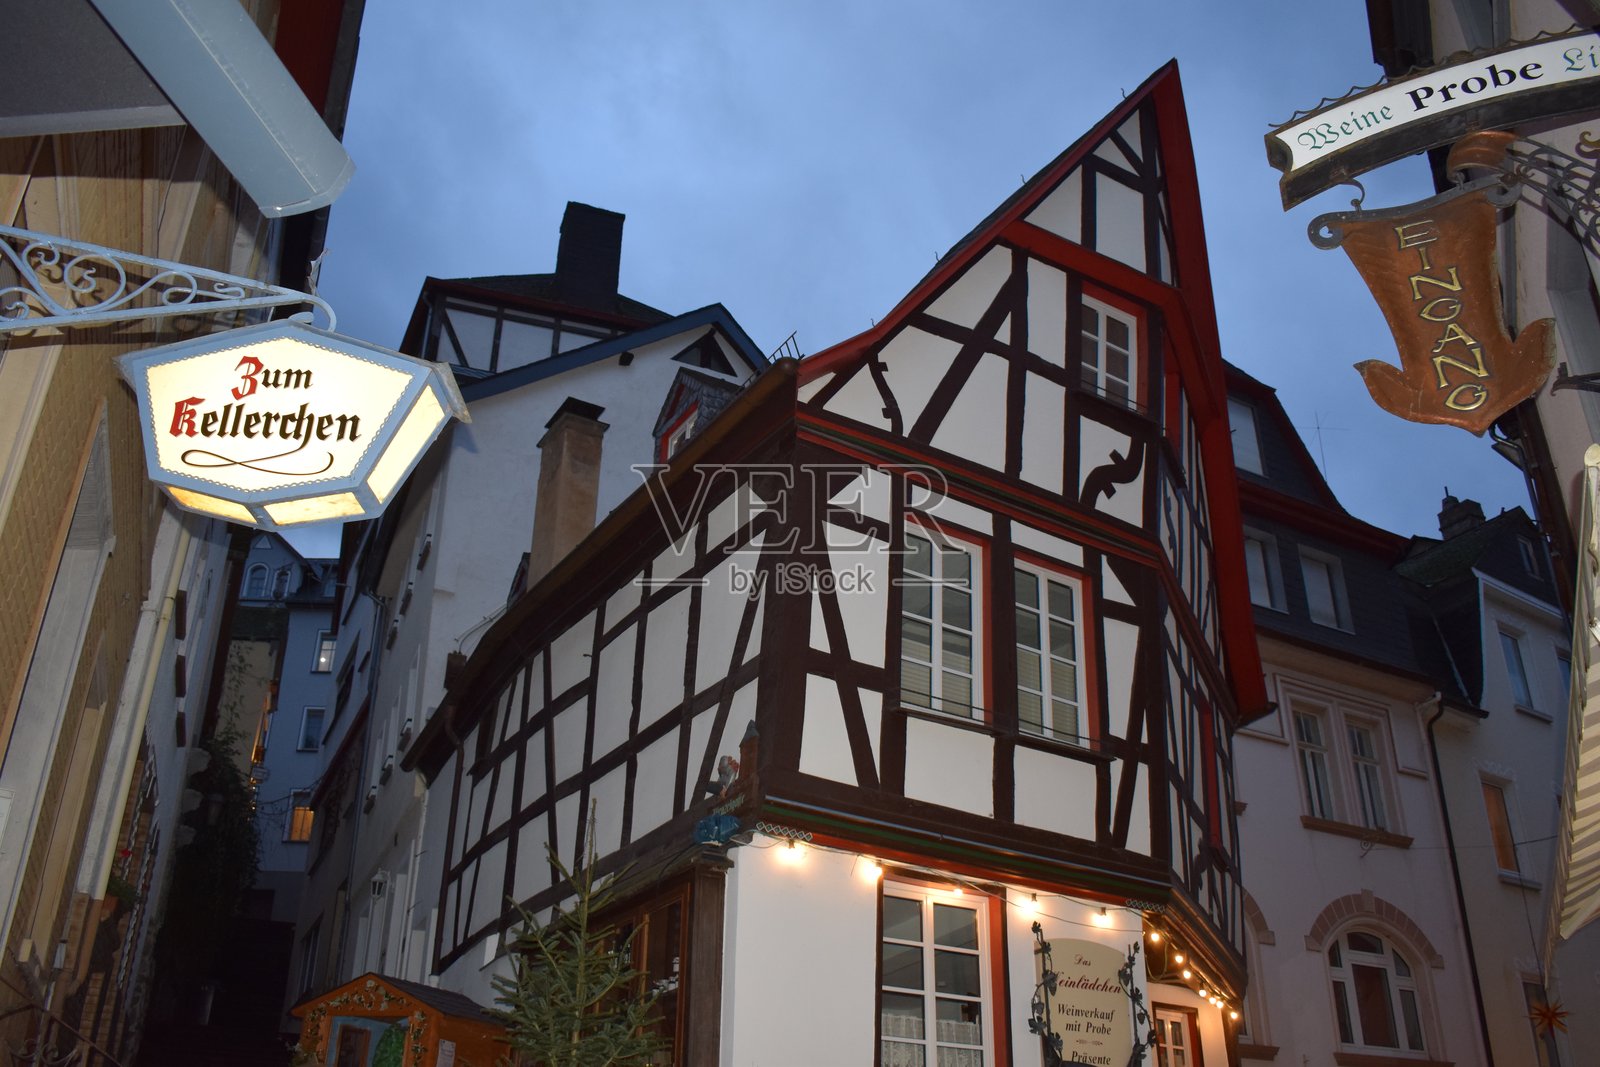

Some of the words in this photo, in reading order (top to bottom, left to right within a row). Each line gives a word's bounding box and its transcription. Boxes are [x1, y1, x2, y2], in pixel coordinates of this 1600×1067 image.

[1297, 103, 1394, 151] Weine
[1405, 62, 1544, 112] Probe
[1563, 45, 1600, 73] Li
[1394, 219, 1490, 412] EINGANG
[231, 355, 313, 400] Zum
[169, 396, 361, 446] Kellerchen
[1074, 953, 1092, 967] Das
[1056, 972, 1122, 995] einlädchen
[1057, 1003, 1116, 1023] Weinverkauf
[1065, 1020, 1082, 1032] mit
[1085, 1022, 1112, 1035] Probe
[1071, 1050, 1112, 1066] Präsente
